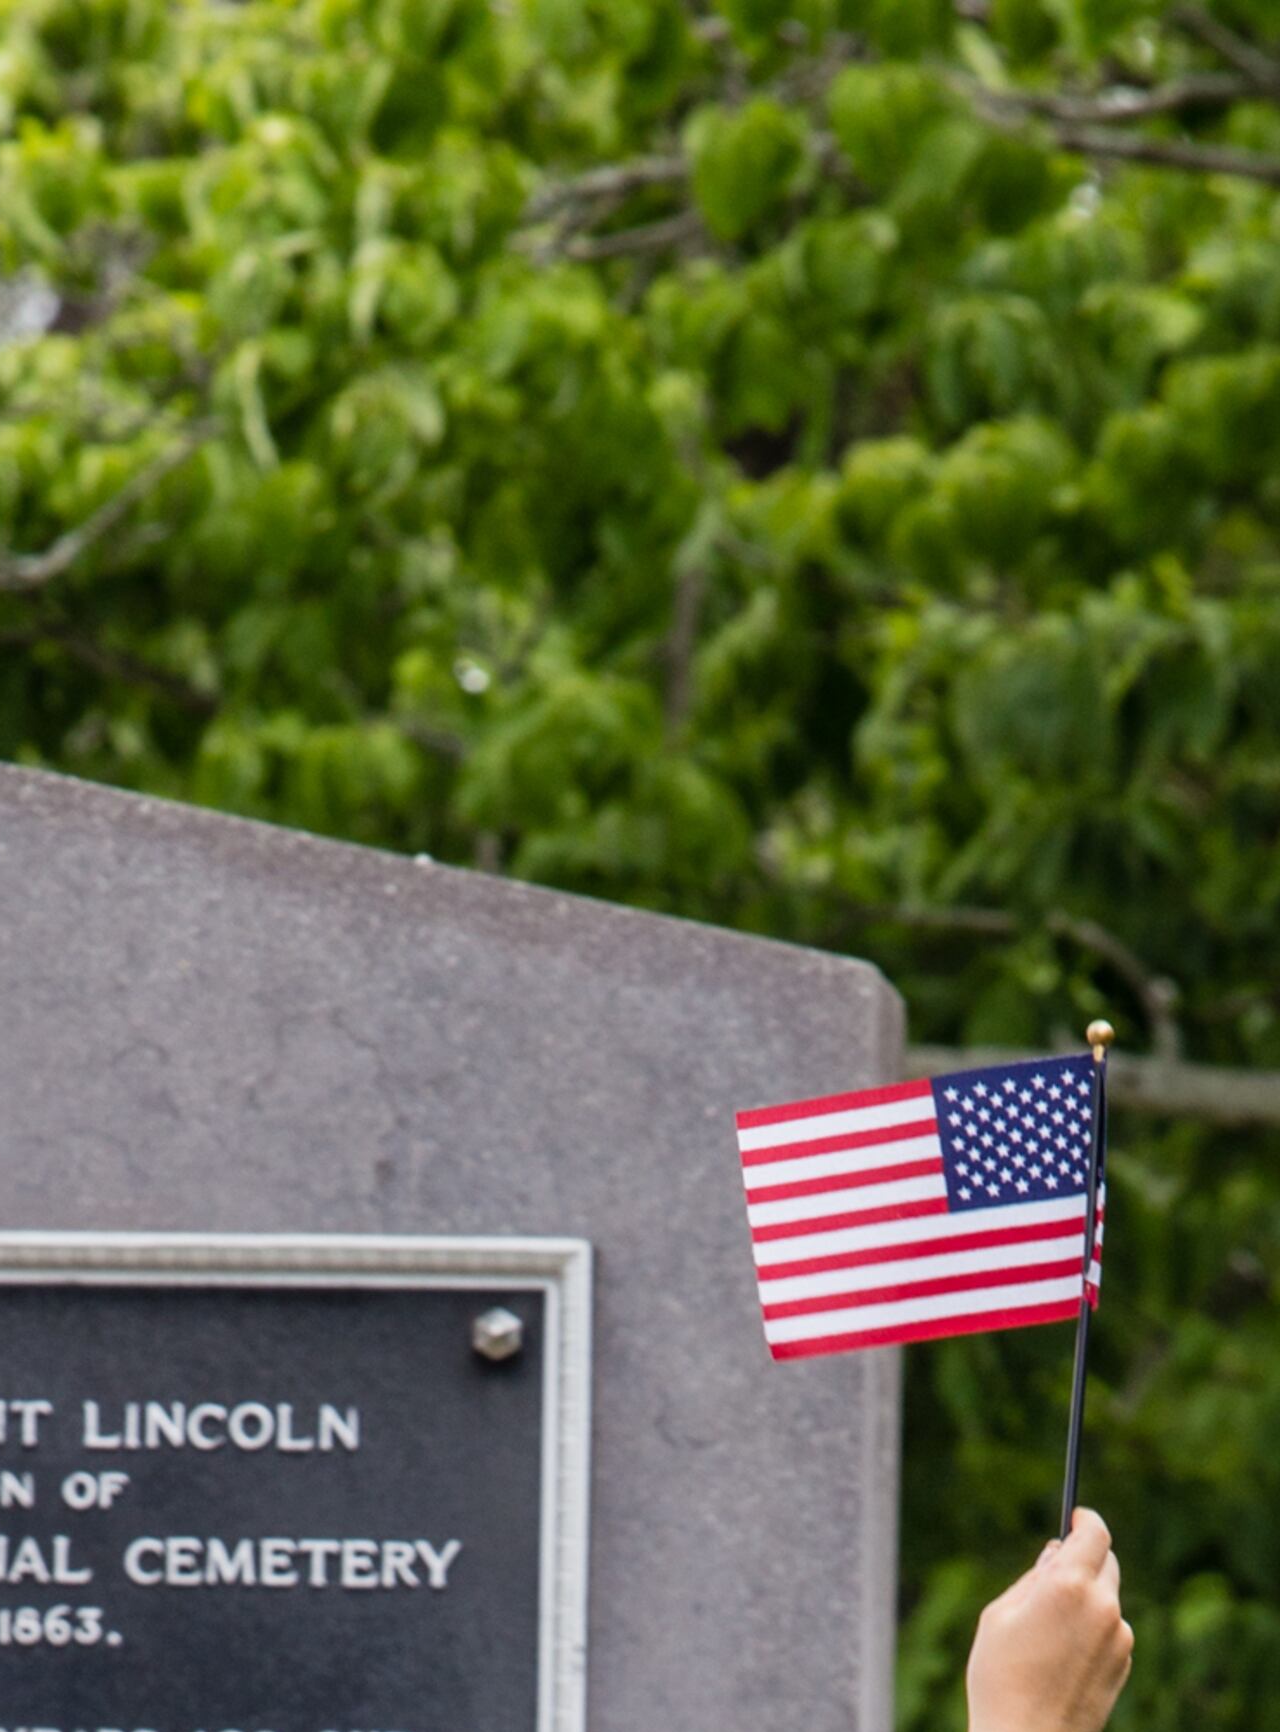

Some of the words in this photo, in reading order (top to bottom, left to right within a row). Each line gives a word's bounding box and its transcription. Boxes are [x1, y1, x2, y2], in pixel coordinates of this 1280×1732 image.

[83, 1400, 360, 1451] LINCOLN
[62, 1471, 130, 1510] OF
[124, 1537, 461, 1589] CEMETERY
